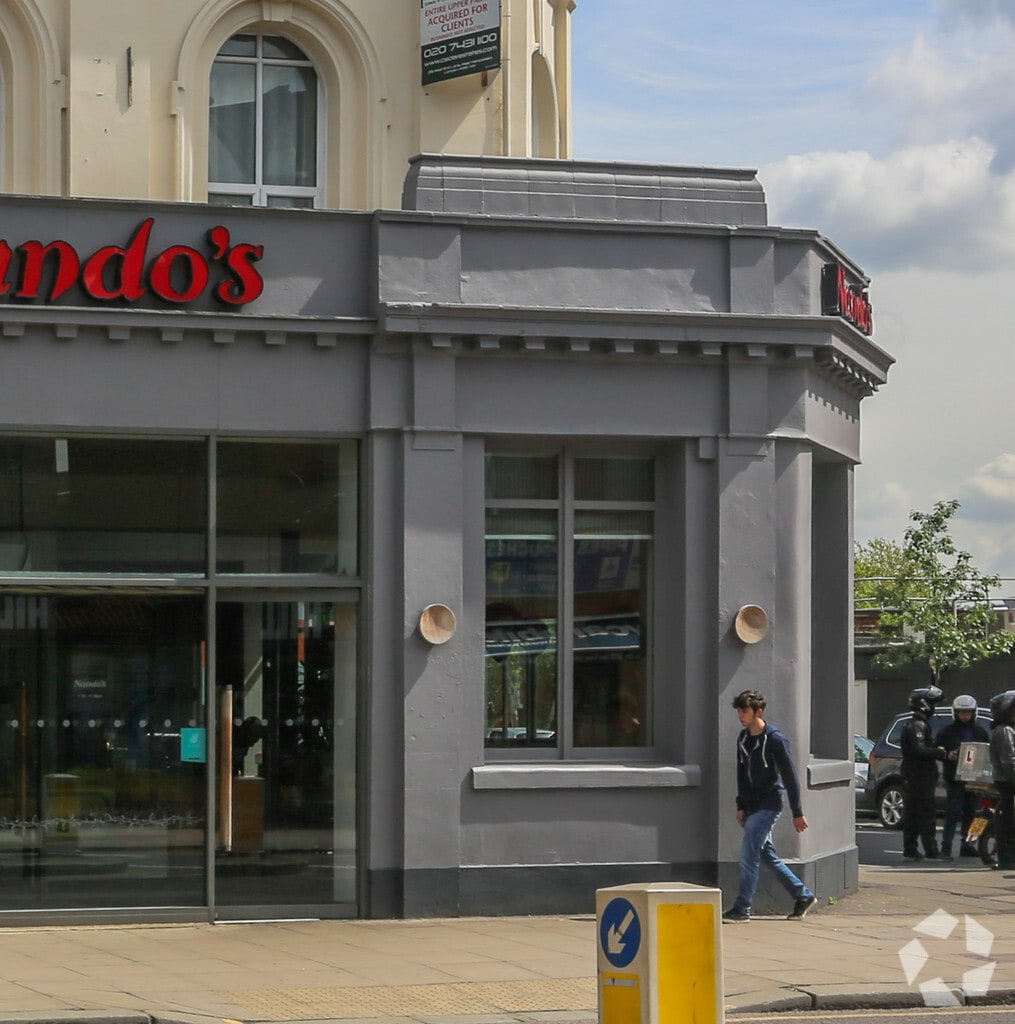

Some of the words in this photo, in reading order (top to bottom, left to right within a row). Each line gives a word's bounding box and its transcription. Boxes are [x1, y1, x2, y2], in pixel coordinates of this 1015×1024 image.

[425, 6, 446, 17] ENTIRE
[447, 0, 469, 10] UPPER
[427, 8, 470, 26] ACQUIRED
[472, 3, 489, 15] FOR
[441, 17, 474, 32] CLIENTS
[424, 45, 447, 58] 020
[449, 38, 476, 52] 7431
